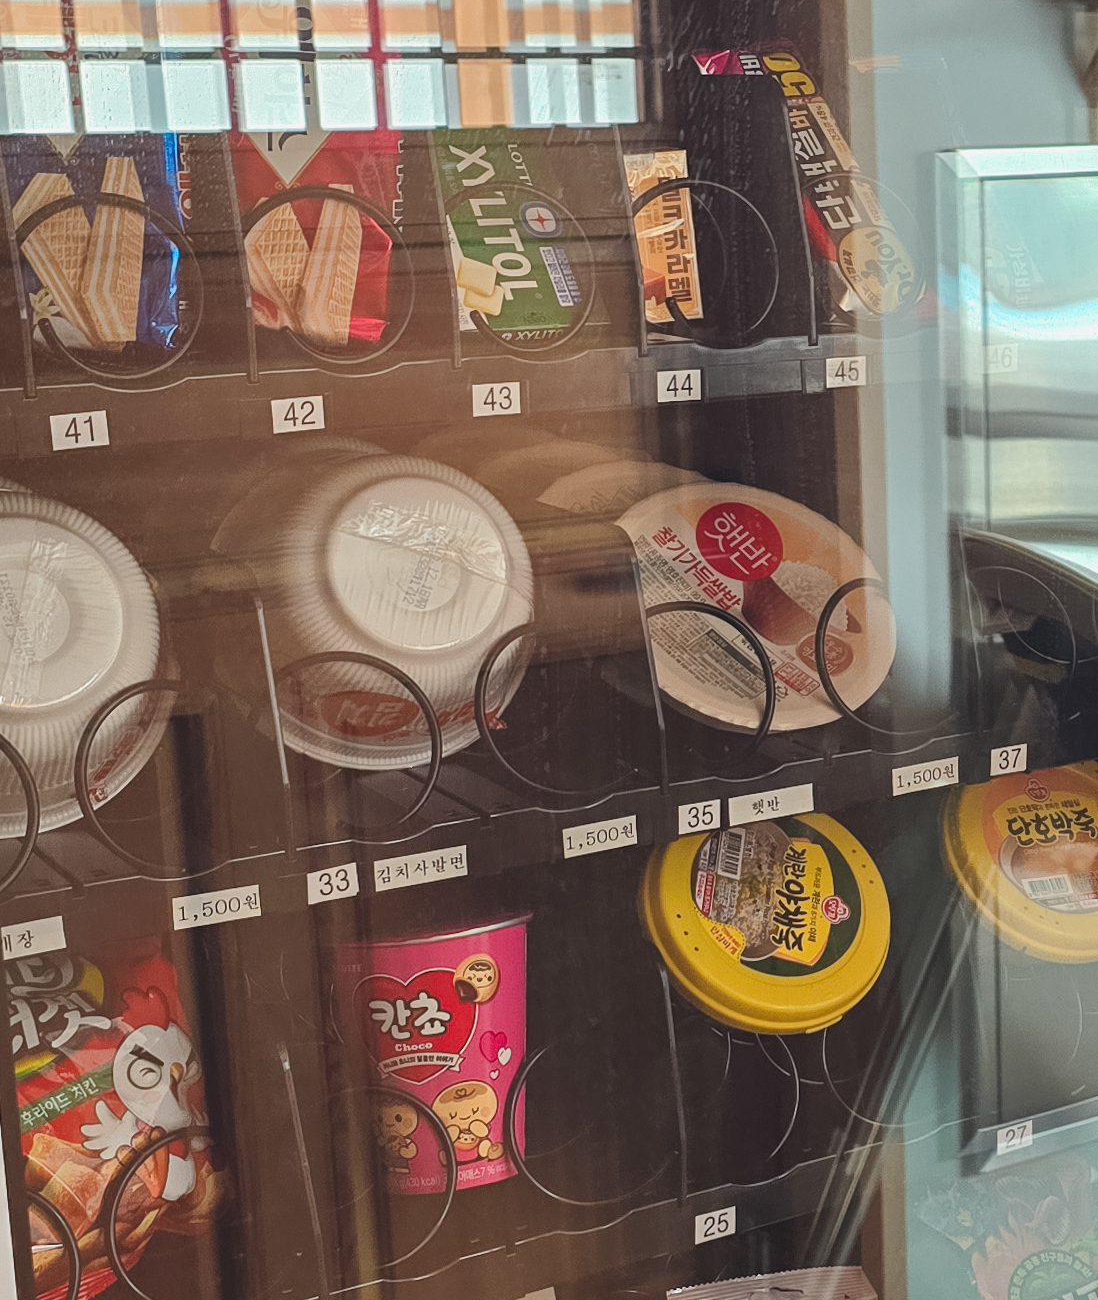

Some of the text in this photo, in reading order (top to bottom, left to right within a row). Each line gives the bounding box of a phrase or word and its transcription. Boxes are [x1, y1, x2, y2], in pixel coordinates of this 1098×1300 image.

[762, 52, 816, 97] 50
[666, 373, 693, 398] 44
[834, 359, 859, 383] 45
[483, 385, 512, 411] 43
[283, 400, 316, 428] 42
[64, 414, 95, 445] 41
[704, 511, 774, 575] 햇반
[652, 525, 741, 611] 찰기가득쌀밥
[998, 748, 1022, 770] 37
[895, 762, 955, 790] 1,500원
[687, 804, 714, 829] 35
[1006, 807, 1097, 847] 단호박죽
[565, 821, 635, 851] 1,500원
[376, 852, 465, 884] 김치사발면
[318, 871, 352, 897] 33
[770, 844, 811, 952] 계란야채죽
[176, 892, 260, 923] 1,500원
[368, 991, 451, 1040] 칸쵸
[394, 1042, 433, 1052] Choco
[20, 1077, 99, 1127] 후라이드 치킨
[1005, 1125, 1027, 1148] 27
[703, 1213, 729, 1237] 25
